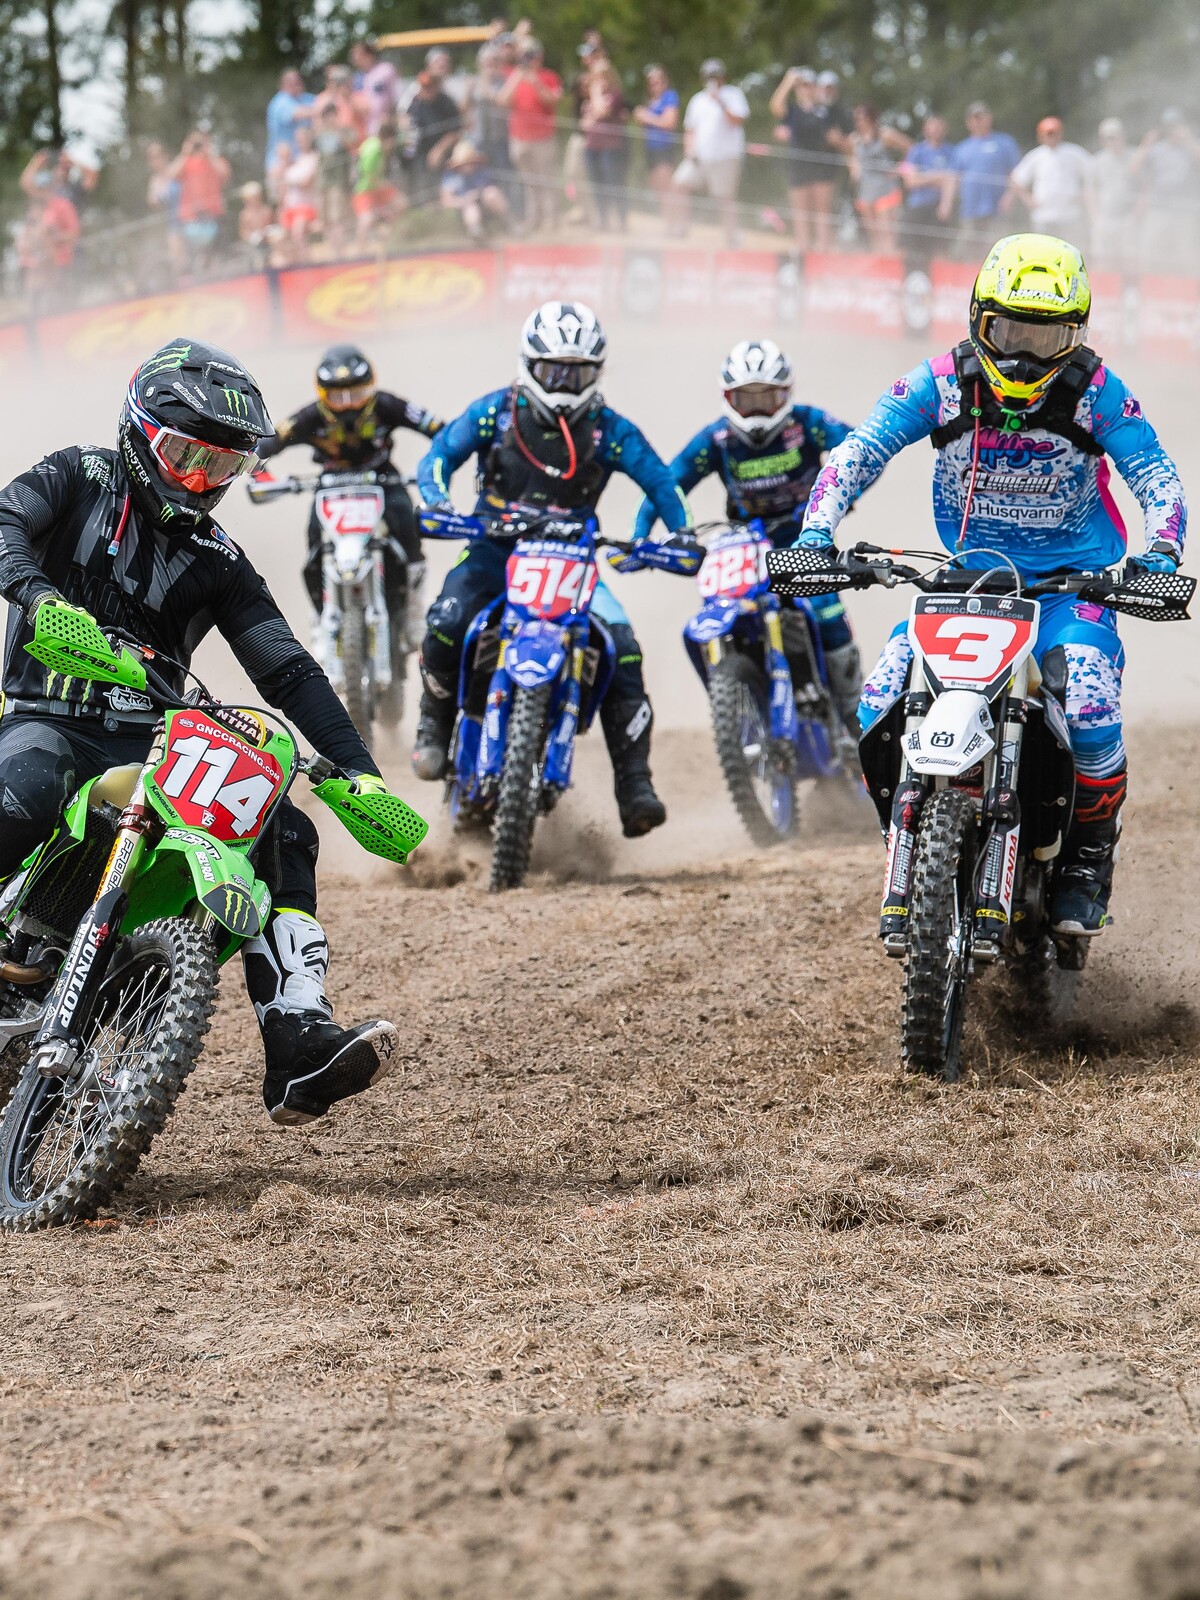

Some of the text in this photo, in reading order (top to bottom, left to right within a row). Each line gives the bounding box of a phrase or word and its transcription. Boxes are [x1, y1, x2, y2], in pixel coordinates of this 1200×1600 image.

[217, 413, 264, 433] MONSTER
[978, 502, 1064, 521] Husqvarna
[508, 557, 597, 605] 514
[58, 645, 119, 674] ACERBIS
[926, 616, 1018, 679] 3
[196, 723, 280, 782] GNCCRACING.COM
[150, 785, 177, 820] Kawasaki
[170, 735, 275, 837] 114
[1003, 834, 1018, 903] KENDA
[59, 922, 100, 1028] DUNLOP
